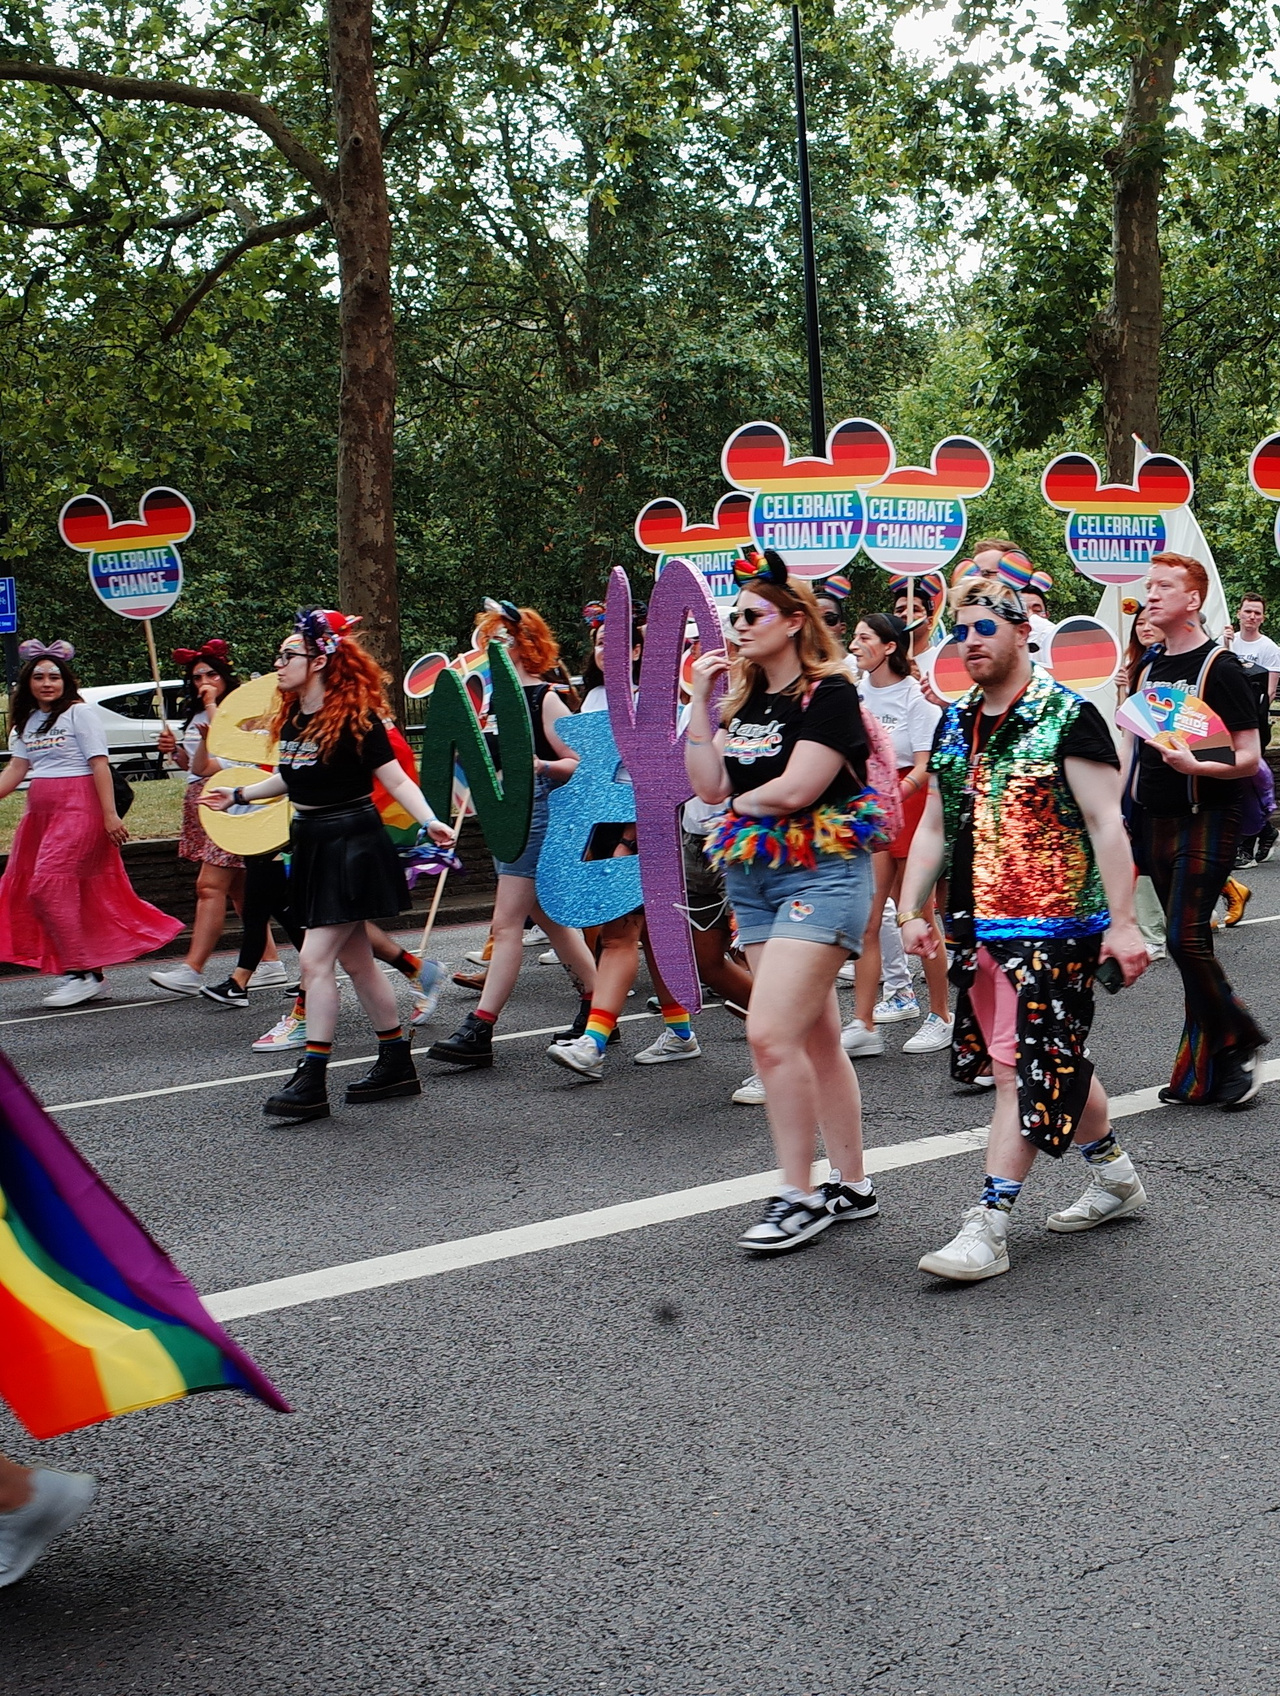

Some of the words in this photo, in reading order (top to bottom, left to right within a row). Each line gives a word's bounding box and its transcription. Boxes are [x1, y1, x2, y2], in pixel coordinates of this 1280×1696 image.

[763, 493, 854, 520] CELEBRATE
[869, 498, 955, 523] CELEBRATE
[763, 521, 854, 550] EQUALITY
[876, 523, 947, 549] CHANGE
[1077, 515, 1158, 537] CELEBRATE
[97, 548, 171, 574] CELEBRATE
[1078, 538, 1158, 562] EQUALITY
[108, 571, 169, 597] CHANGE
[50, 727, 67, 735] the
[1173, 712, 1209, 731] PRIDE
[420, 639, 535, 864] N
